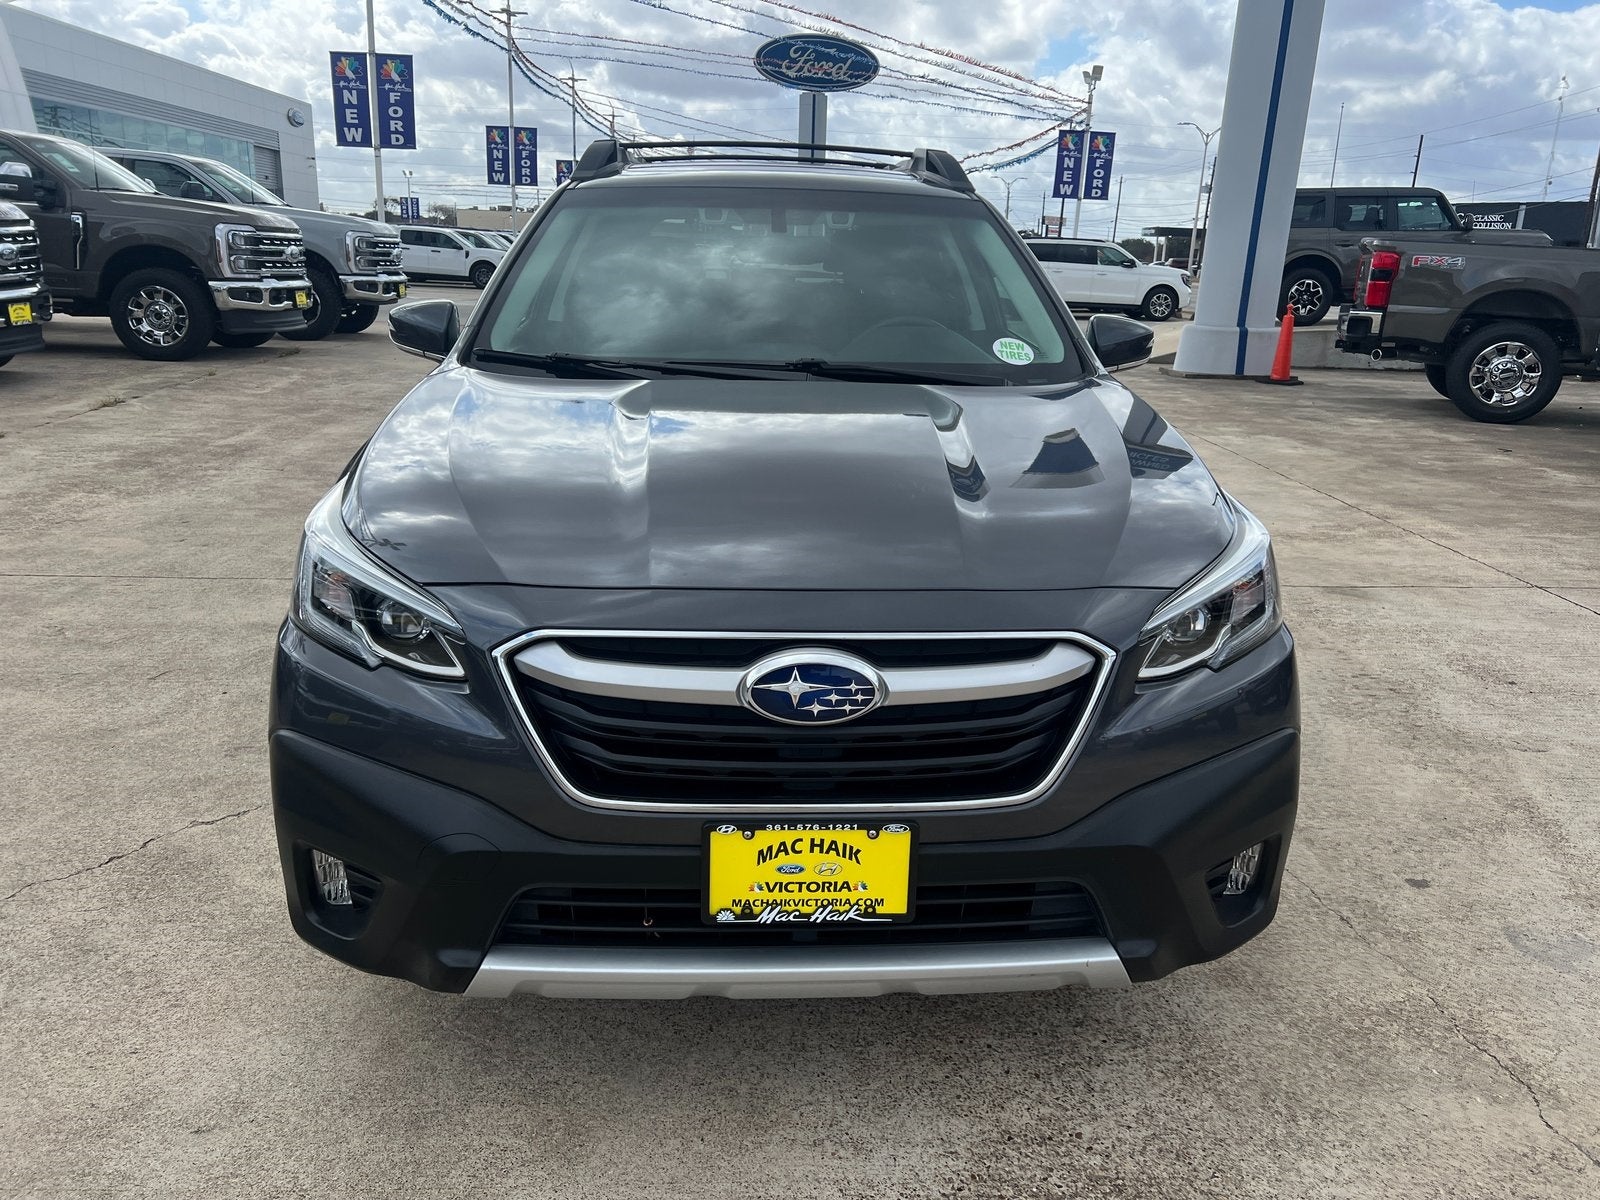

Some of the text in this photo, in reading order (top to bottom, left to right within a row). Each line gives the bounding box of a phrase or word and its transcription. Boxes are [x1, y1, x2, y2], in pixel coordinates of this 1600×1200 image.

[781, 44, 852, 80] Ford
[342, 89, 363, 143] NEW
[388, 92, 405, 145] FORD
[492, 149, 505, 182] NEW
[521, 150, 531, 184] FORD
[1059, 157, 1075, 195] NEW
[1091, 159, 1105, 197] FORD
[1472, 222, 1512, 230] COLLISION
[1473, 214, 1504, 222] CLASSIC
[1411, 255, 1465, 269] FX4
[998, 349, 1032, 362] TIRES
[1000, 340, 1025, 351] NEW
[765, 823, 859, 831] 361-576-1221
[756, 837, 862, 867] MAC HAIK
[764, 881, 853, 893] VICTORIA
[731, 898, 885, 908] MACHAIKVICTORIACOM
[756, 904, 862, 924] Mac Haik
